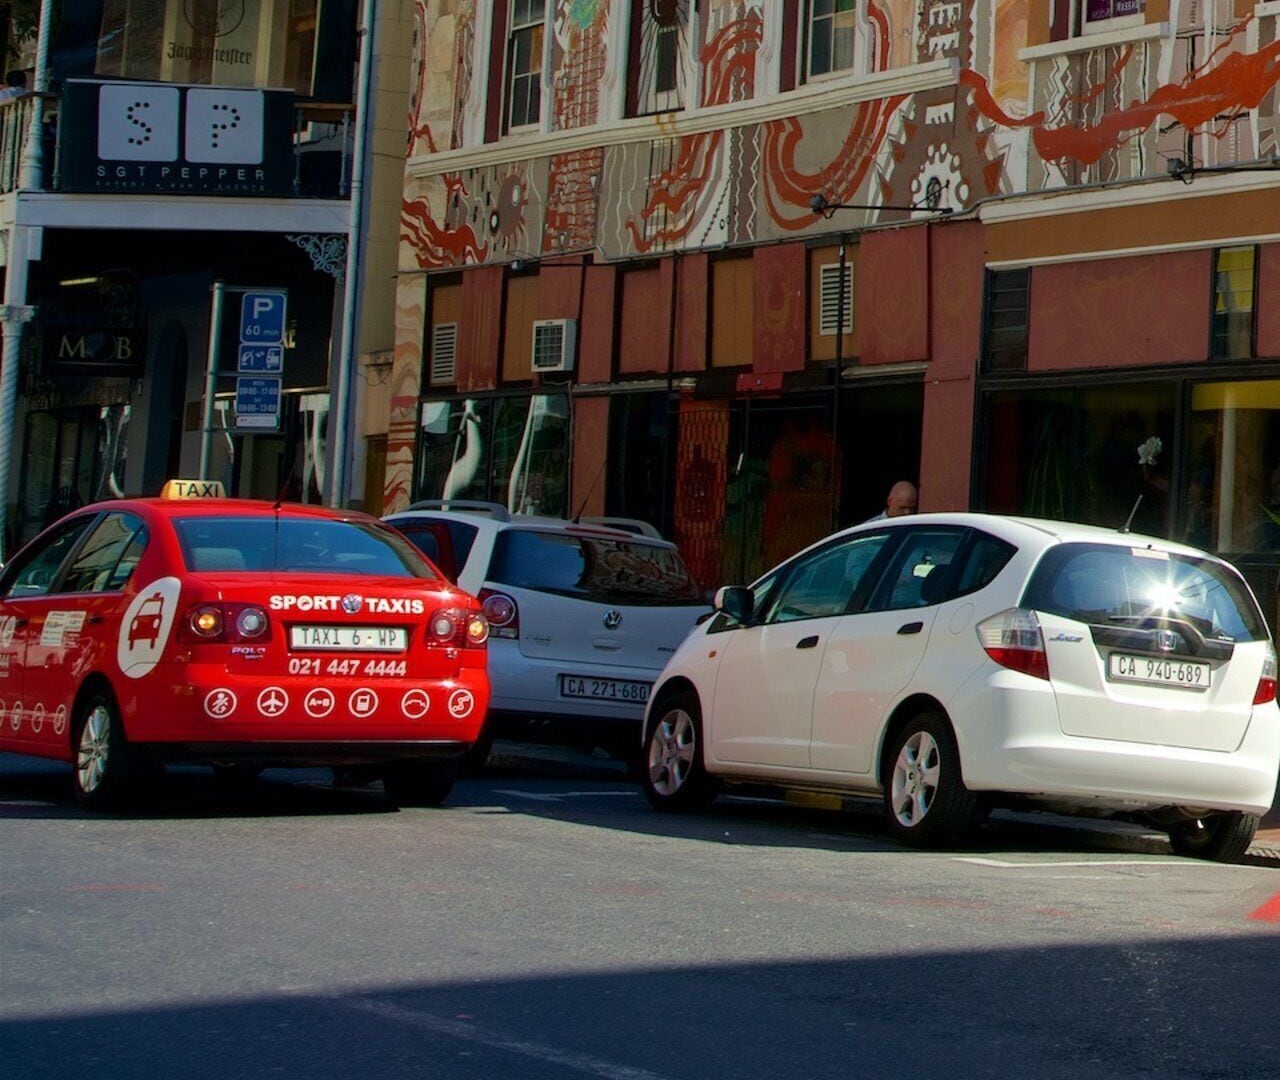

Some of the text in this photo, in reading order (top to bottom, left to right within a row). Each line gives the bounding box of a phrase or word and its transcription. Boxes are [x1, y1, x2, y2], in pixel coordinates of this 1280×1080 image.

[97, 165, 265, 181] SGT PEPPER
[253, 297, 274, 319] P
[245, 325, 260, 336] 60
[175, 482, 219, 498] TAXI
[269, 595, 424, 614] SPORT TAXIS
[302, 628, 341, 645] TAXI
[351, 629, 361, 645] 6
[288, 659, 407, 677] 021 447 4444
[1119, 656, 1202, 684] CA 940-689
[568, 679, 647, 700] CA 271-680
